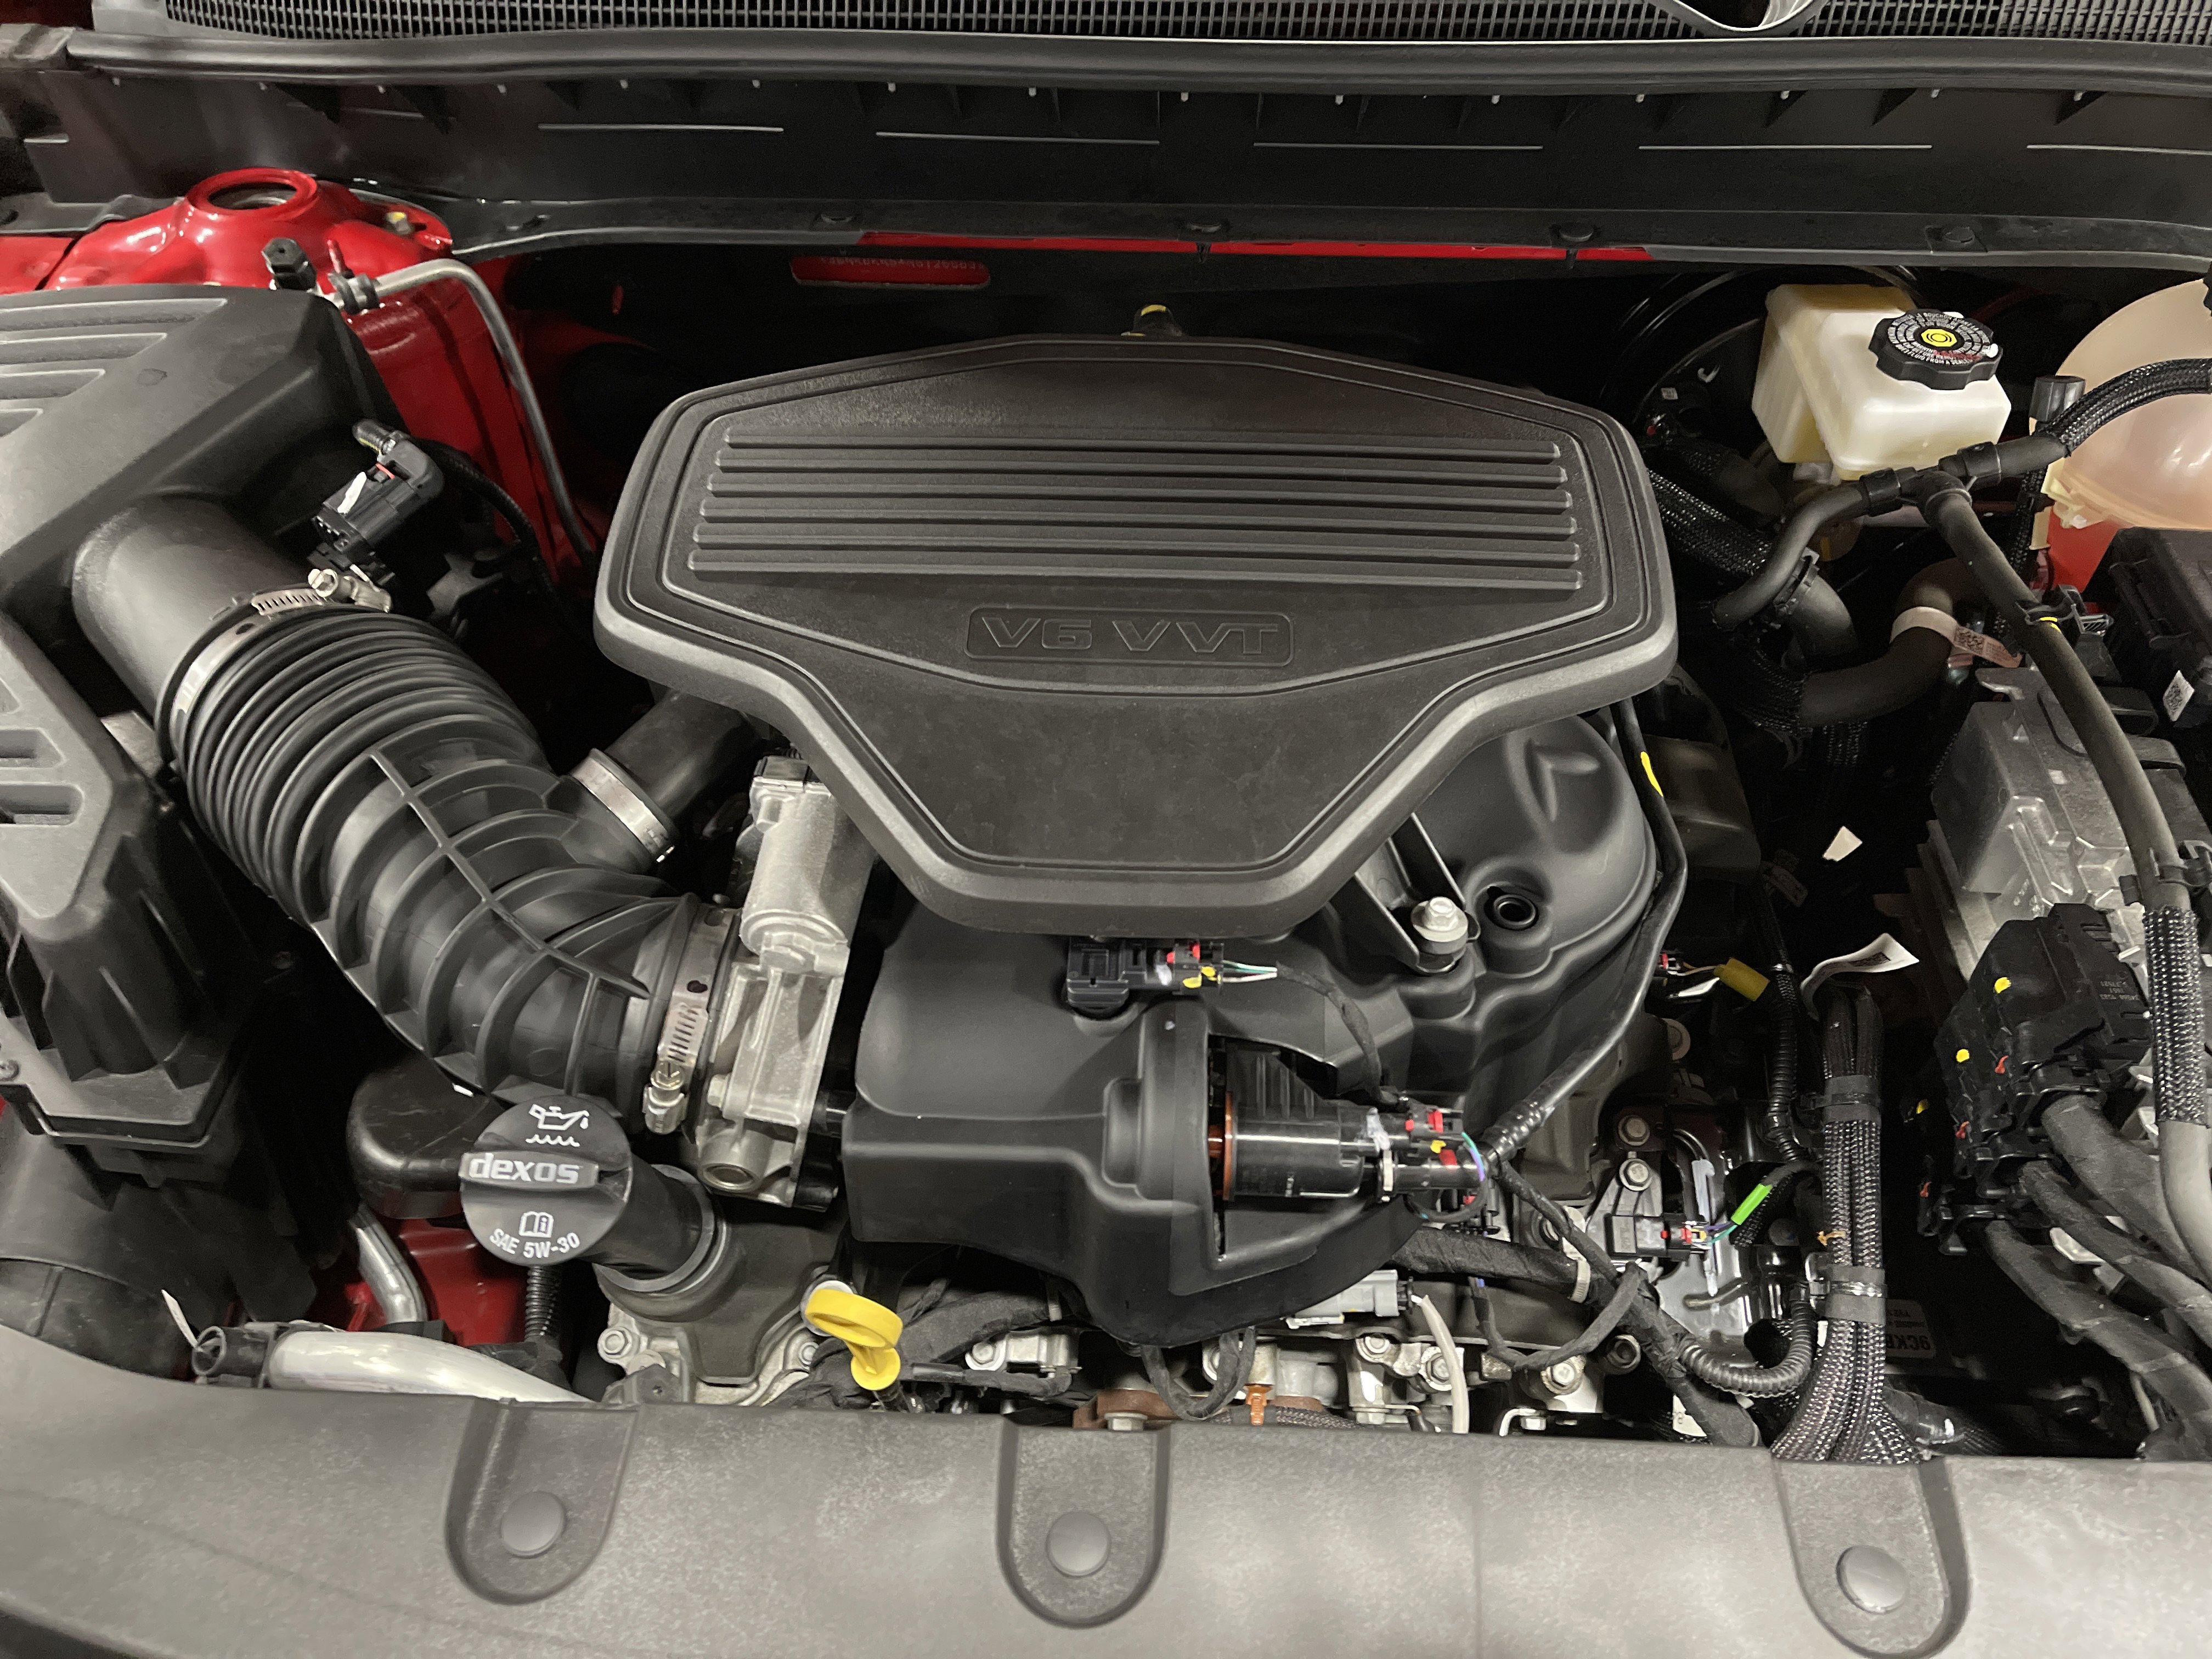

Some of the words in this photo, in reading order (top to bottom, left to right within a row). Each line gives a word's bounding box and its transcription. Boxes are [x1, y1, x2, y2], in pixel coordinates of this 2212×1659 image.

[981, 617, 1092, 650] V6
[1112, 620, 1278, 654] VVT
[469, 1153, 580, 1184] dexos
[489, 1228, 520, 1255] SAE
[523, 1232, 580, 1259] 5W-30
